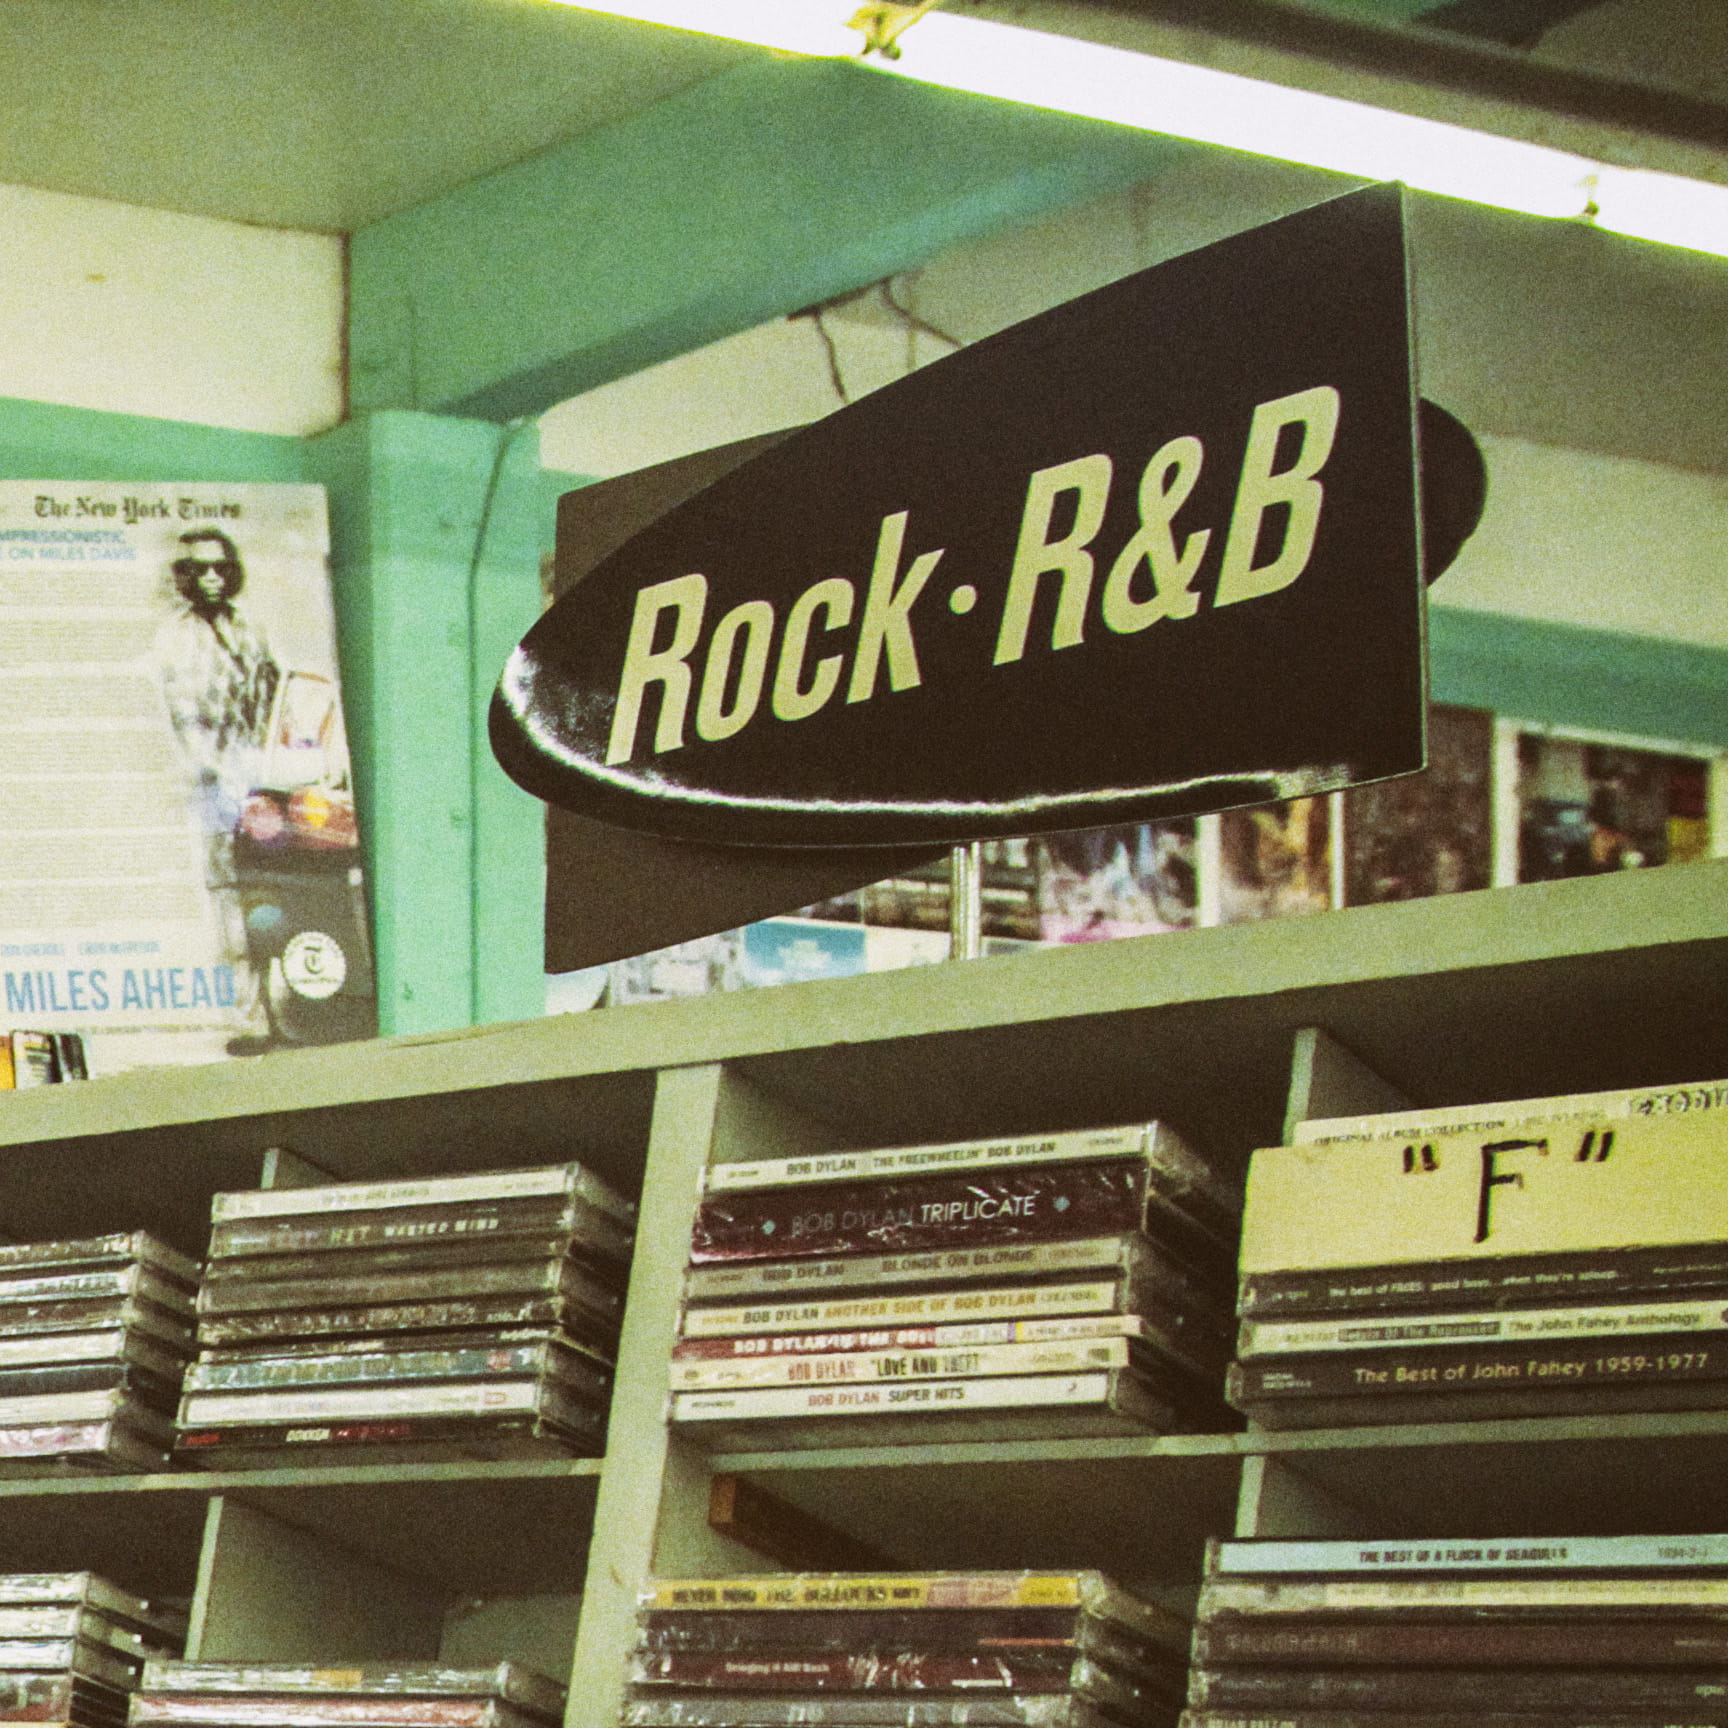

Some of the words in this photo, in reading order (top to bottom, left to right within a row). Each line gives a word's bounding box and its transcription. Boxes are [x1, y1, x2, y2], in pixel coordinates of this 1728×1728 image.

[33, 496, 70, 520] The
[75, 496, 118, 520] New
[123, 496, 172, 525] York
[178, 497, 240, 521] Times
[3, 967, 112, 1013] MILES
[120, 963, 237, 1011] AHEAD
[785, 1161, 813, 1175] BOB
[814, 1158, 856, 1173] DYLAN
[986, 1145, 1013, 1159] BOB
[1015, 1141, 1055, 1156] DYLAN
[790, 1212, 835, 1233] BOB
[919, 1196, 1035, 1223] TRIPLICATE
[774, 1307, 818, 1322] DYLAN
[1354, 1368, 1388, 1385] The
[1395, 1366, 1438, 1383] Best
[1443, 1365, 1466, 1381] of
[1472, 1362, 1520, 1379] John
[1526, 1357, 1585, 1378] Fahey
[1358, 1551, 1380, 1563] THE
[1445, 1550, 1483, 1562] FLOCK
[1486, 1549, 1501, 1562] OF
